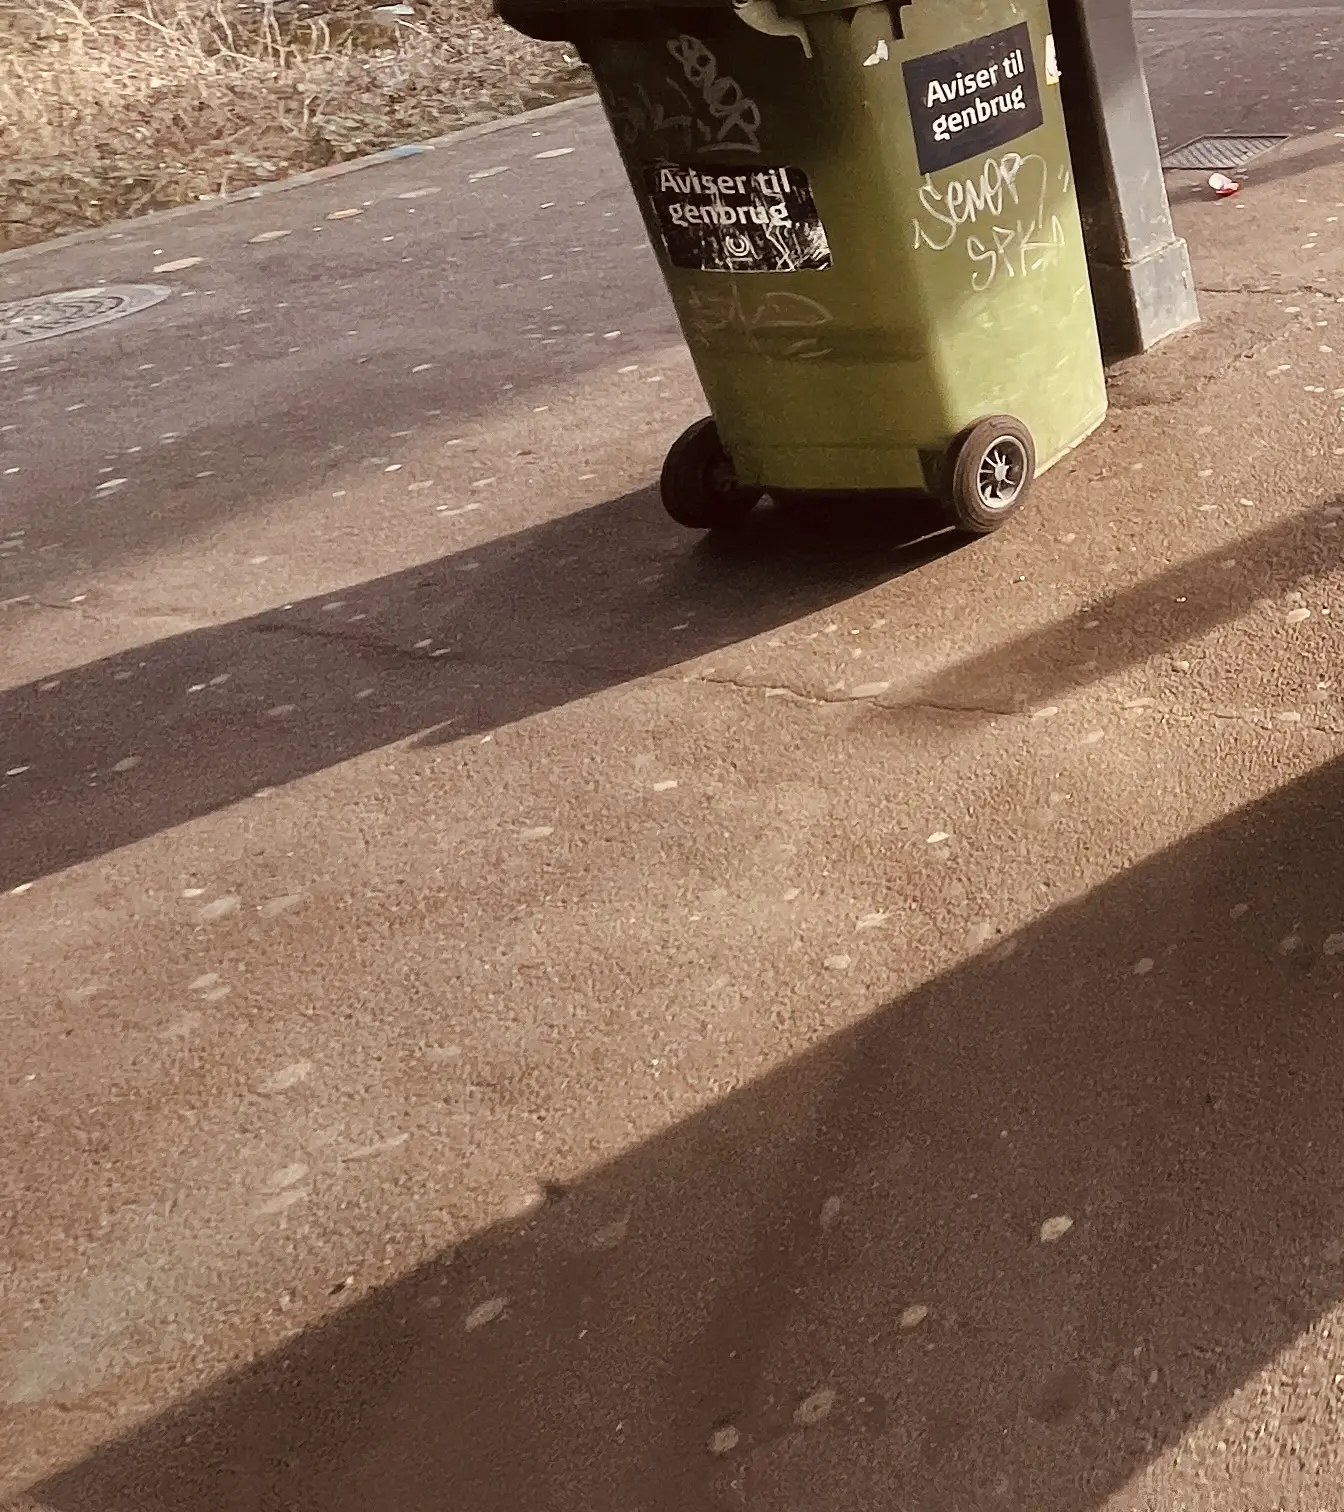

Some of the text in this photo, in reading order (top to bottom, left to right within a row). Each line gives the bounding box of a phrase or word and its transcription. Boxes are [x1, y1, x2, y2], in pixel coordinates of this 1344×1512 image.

[927, 49, 1024, 108] Aviser til
[932, 85, 1026, 141] genbrug
[660, 167, 790, 193] Aviser til
[668, 201, 792, 228] genbrug
